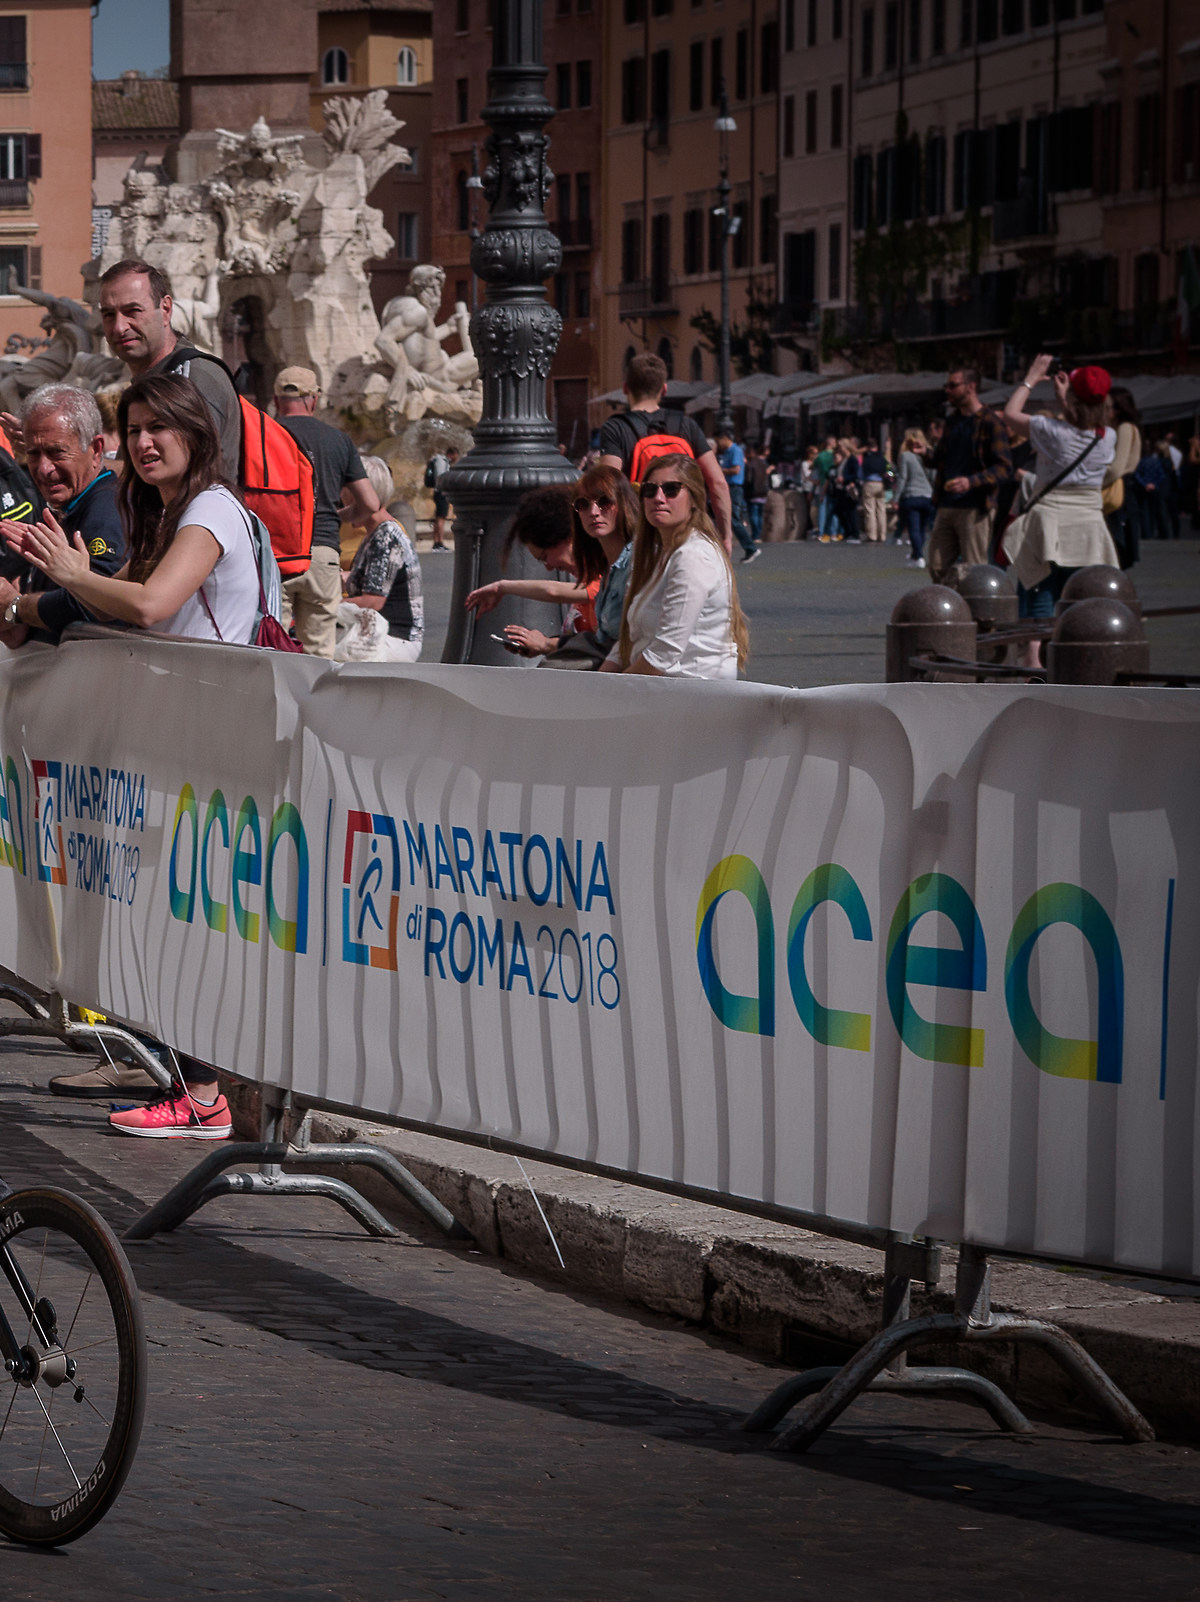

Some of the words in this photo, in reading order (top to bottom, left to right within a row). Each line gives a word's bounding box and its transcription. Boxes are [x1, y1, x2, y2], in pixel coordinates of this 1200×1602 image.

[65, 763, 145, 833] MARATONA
[169, 781, 309, 955] acea
[402, 819, 616, 916] MARATONA
[406, 903, 422, 941] di
[695, 854, 1125, 1085] acea
[49, 1459, 106, 1522] CORIMA
